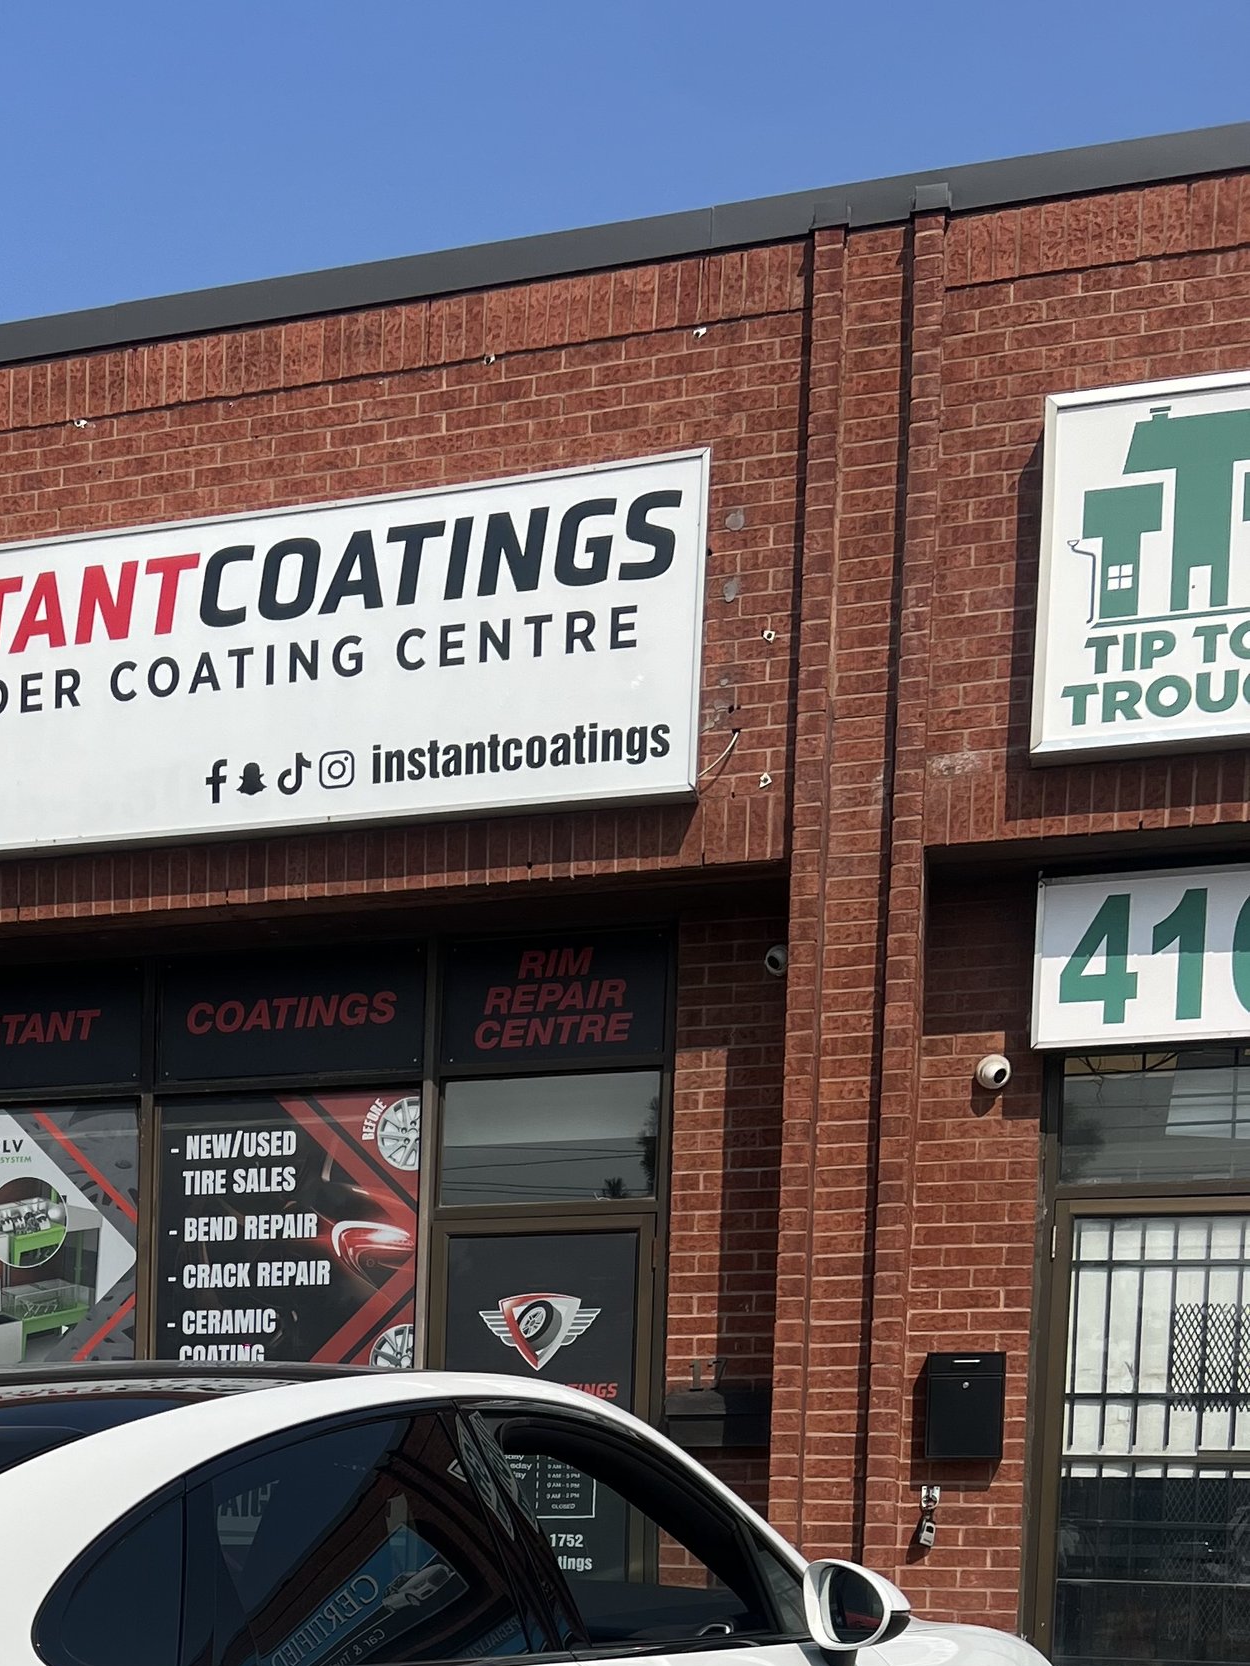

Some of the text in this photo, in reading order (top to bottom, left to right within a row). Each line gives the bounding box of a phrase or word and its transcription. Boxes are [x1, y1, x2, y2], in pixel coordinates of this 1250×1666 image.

[110, 634, 364, 701] COATING
[396, 604, 638, 671] CENTRE
[1085, 630, 1176, 676] TIP
[1061, 669, 1250, 726] TROU
[372, 722, 670, 785] instantcoatings
[518, 947, 593, 979] RIM
[1059, 888, 1250, 1024] 41
[186, 991, 397, 1036] COATINGS
[483, 979, 627, 1015] REPAIR
[473, 1012, 634, 1050] CENTRE
[362, 1097, 387, 1140] BEFORE
[0, 1155, 32, 1163] SYSTEM
[185, 1130, 297, 1160] NEW/USED
[182, 1166, 297, 1196] TIRE SALES
[183, 1216, 238, 1243] BEND
[243, 1213, 318, 1240] REPAIR
[182, 1262, 252, 1289] CRACK
[256, 1260, 331, 1287] REPAIR
[181, 1308, 277, 1335] CERAMIC
[179, 1343, 265, 1362] COATING
[690, 1357, 727, 1391] 17
